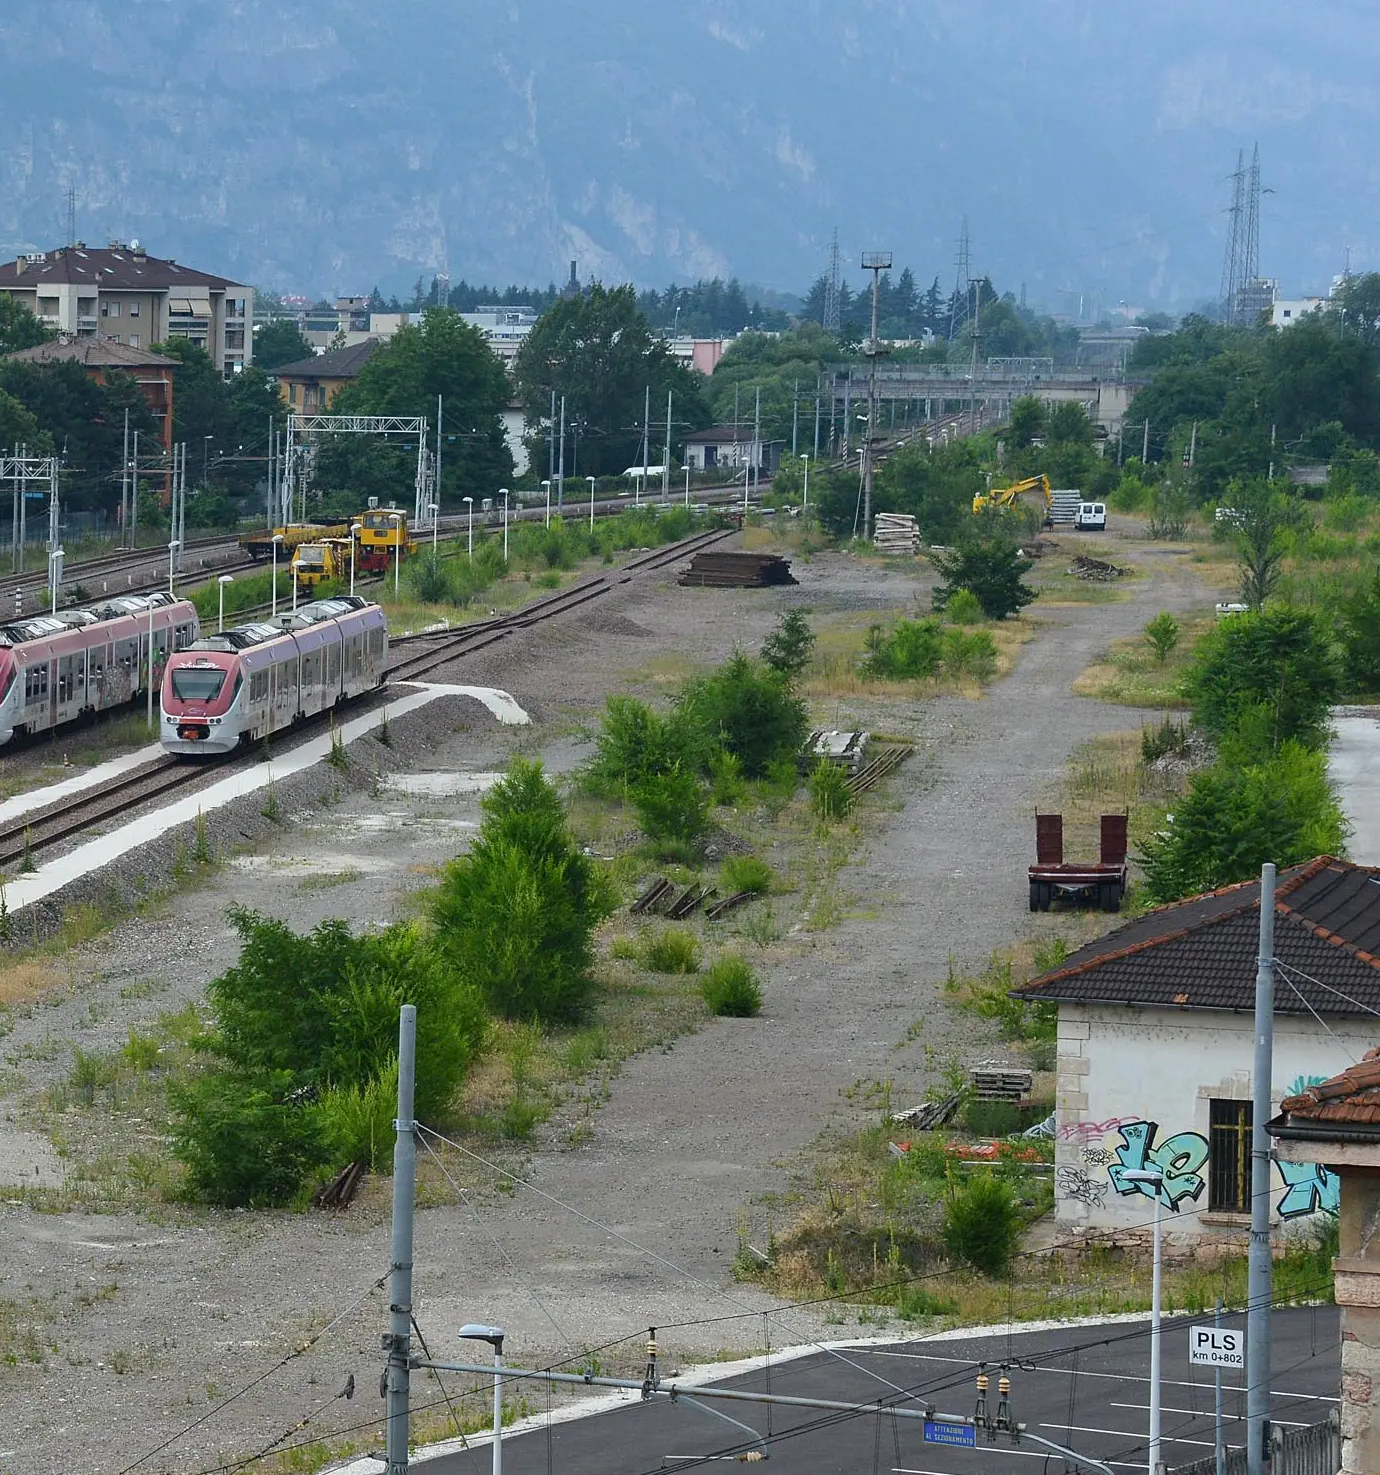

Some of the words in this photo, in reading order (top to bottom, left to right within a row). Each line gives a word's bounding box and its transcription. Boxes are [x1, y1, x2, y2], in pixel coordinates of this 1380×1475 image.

[1198, 1332, 1236, 1351] PLS
[1193, 1350, 1208, 1360] km
[1211, 1352, 1242, 1363] 0+802
[934, 1425, 965, 1435] ATTENZIONE
[925, 1432, 933, 1440] AL
[934, 1434, 974, 1445] SEZIONAMENTO
